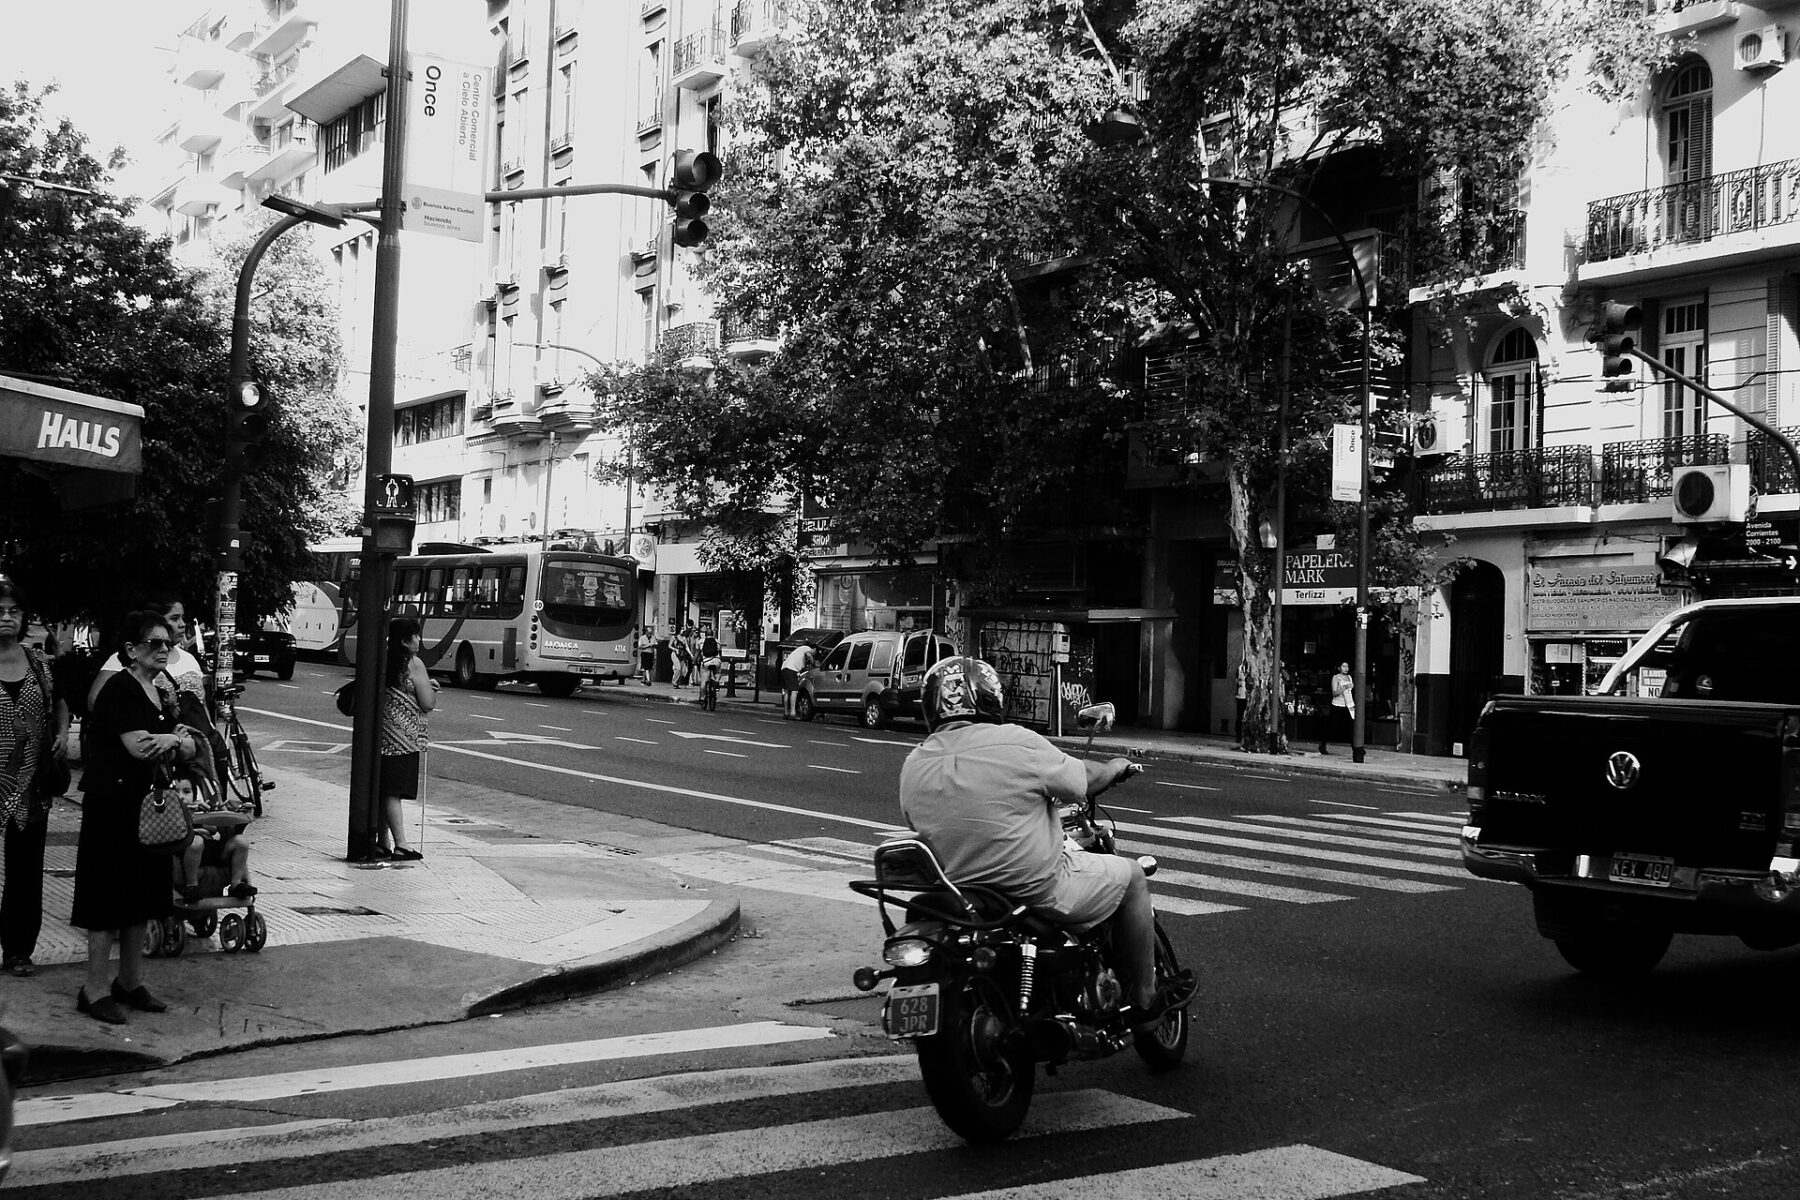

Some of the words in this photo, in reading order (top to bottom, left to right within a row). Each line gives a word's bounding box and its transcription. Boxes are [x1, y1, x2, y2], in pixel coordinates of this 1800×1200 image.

[424, 65, 441, 117] Once
[461, 82, 471, 107] Cielo
[472, 74, 482, 108] Centro
[459, 109, 469, 145] Abierto
[469, 110, 480, 161] Comercial
[443, 203, 456, 212] Aires
[456, 206, 475, 215] Ciudad
[37, 410, 120, 458] HALLS
[1285, 569, 1326, 584] MARK
[1295, 590, 1326, 599] Terlizzi
[544, 640, 579, 650] MONSA
[1612, 859, 1638, 877] KEX
[1644, 862, 1670, 880] 484
[900, 996, 928, 1015] 628
[899, 1014, 928, 1032] JPR
